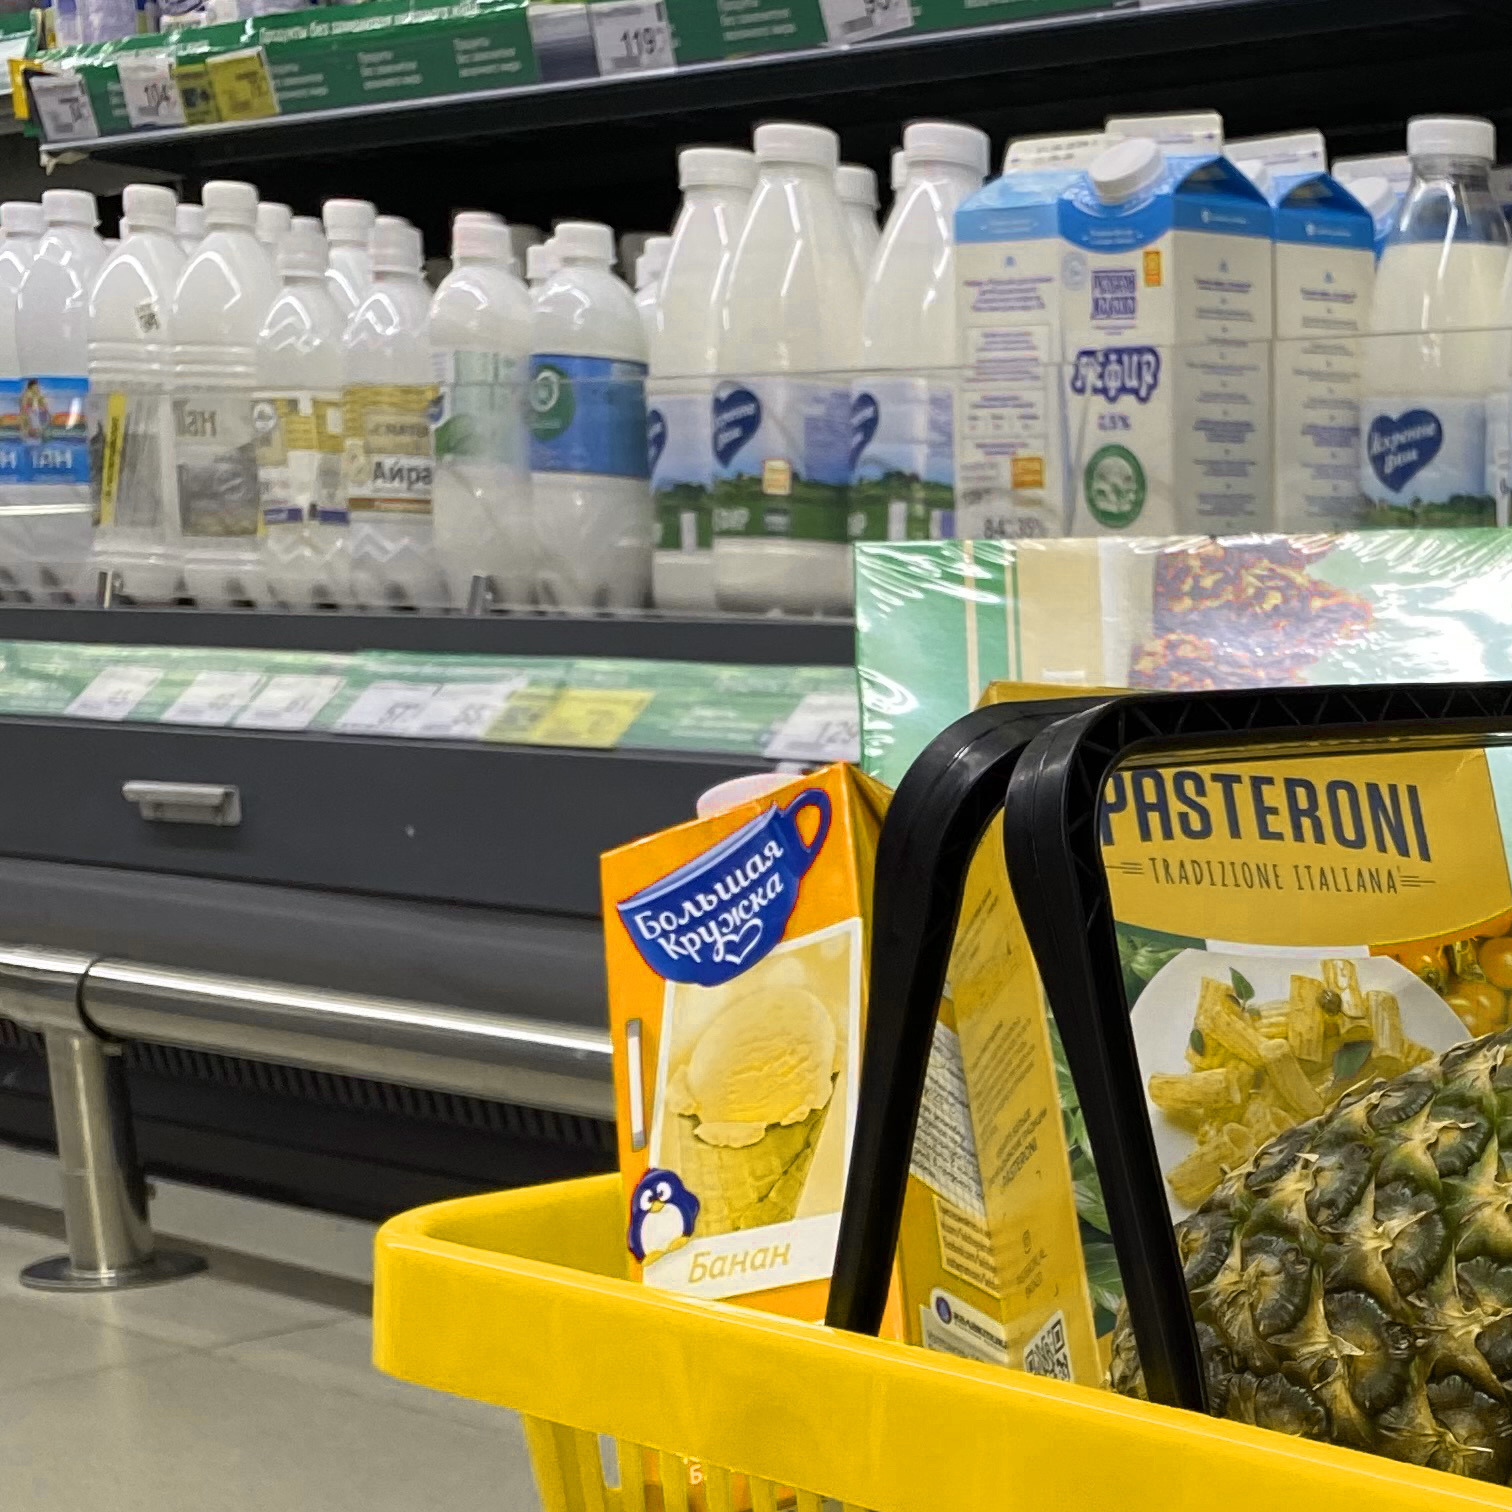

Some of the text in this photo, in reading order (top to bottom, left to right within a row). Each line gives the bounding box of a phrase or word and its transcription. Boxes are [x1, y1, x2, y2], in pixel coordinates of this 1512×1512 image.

[1101, 768, 1434, 863] PASTERONI
[634, 838, 784, 941] Большая
[1149, 856, 1399, 896] TRADIZIONE ITALIANA
[688, 1243, 792, 1285] Банан
